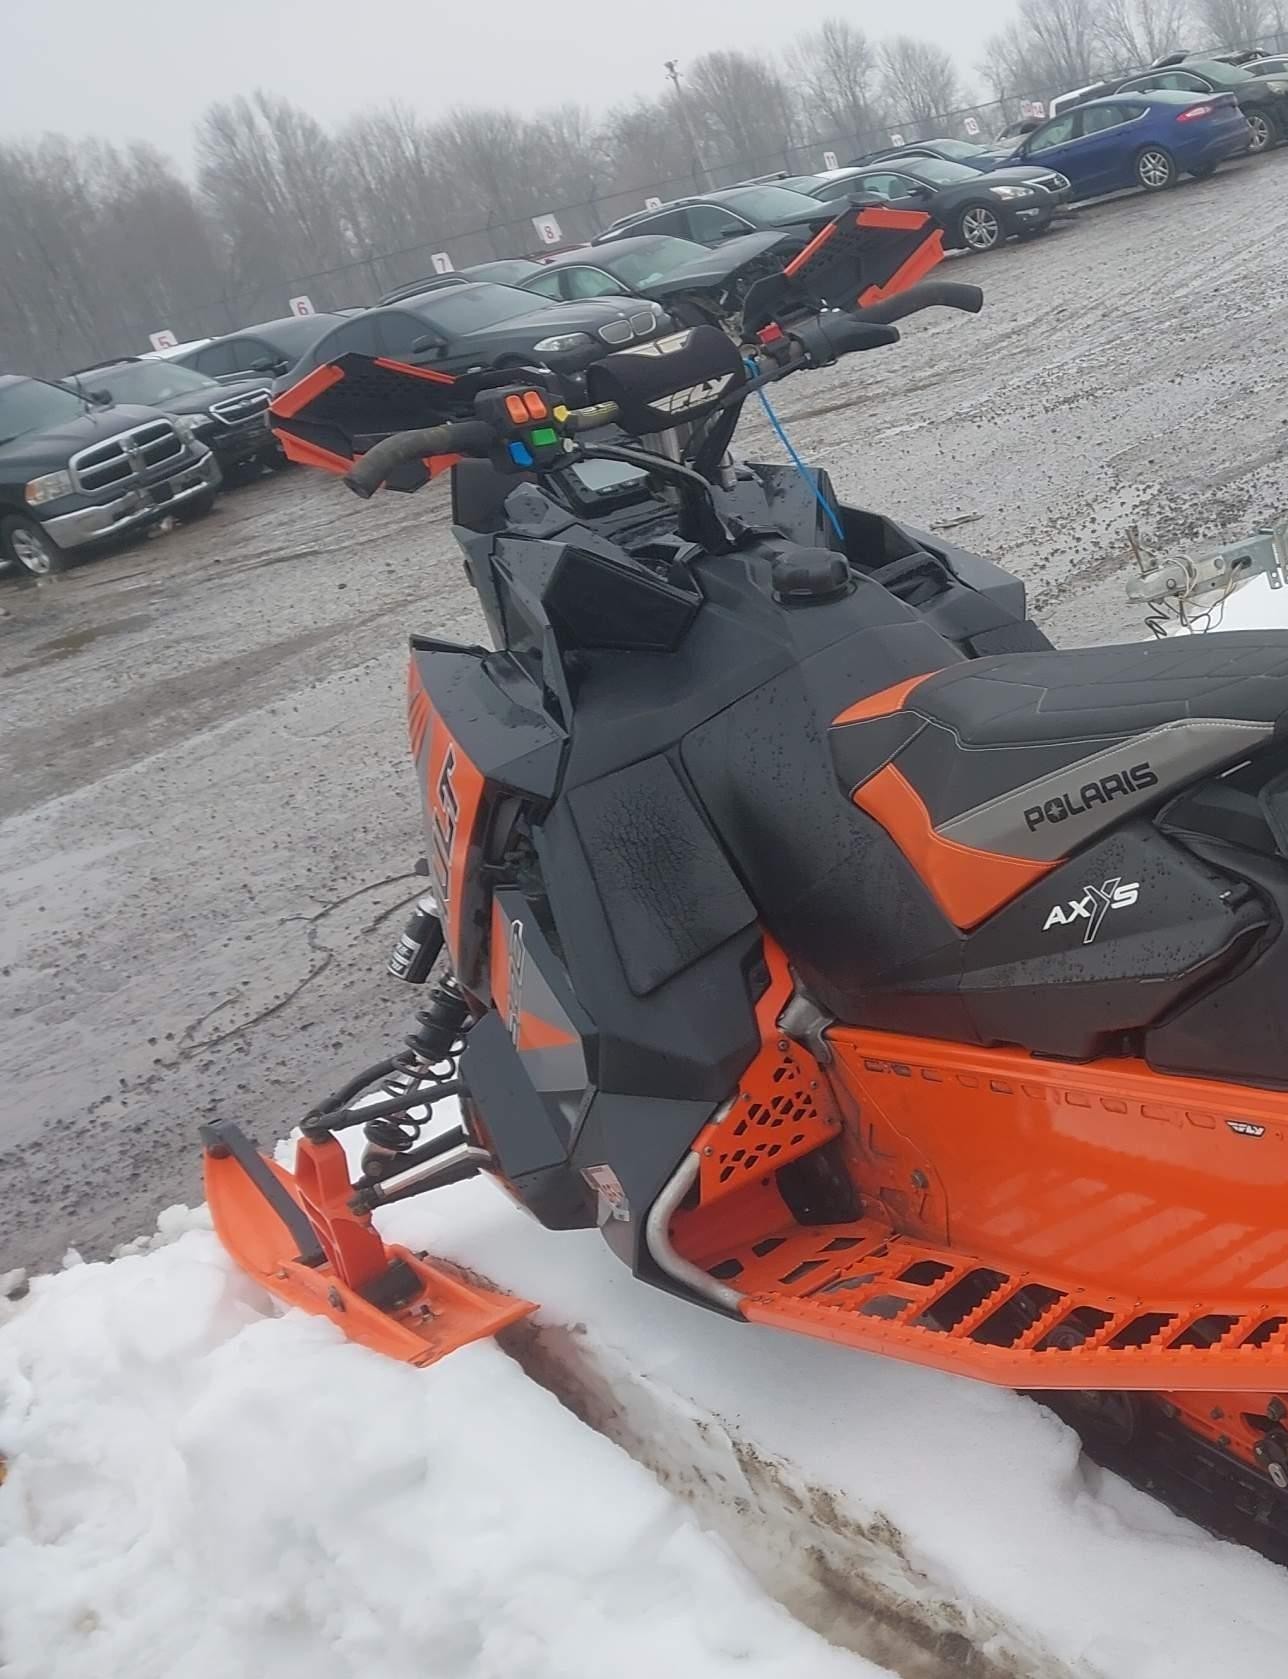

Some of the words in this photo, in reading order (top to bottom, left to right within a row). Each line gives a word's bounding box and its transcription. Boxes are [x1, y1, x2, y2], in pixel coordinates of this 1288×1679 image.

[543, 225, 555, 240] 8
[436, 257, 448, 272] 7
[296, 301, 309, 316] 6
[158, 336, 170, 350] 5
[1024, 762, 1159, 832] POLARIS
[1042, 877, 1140, 944] AXYS
